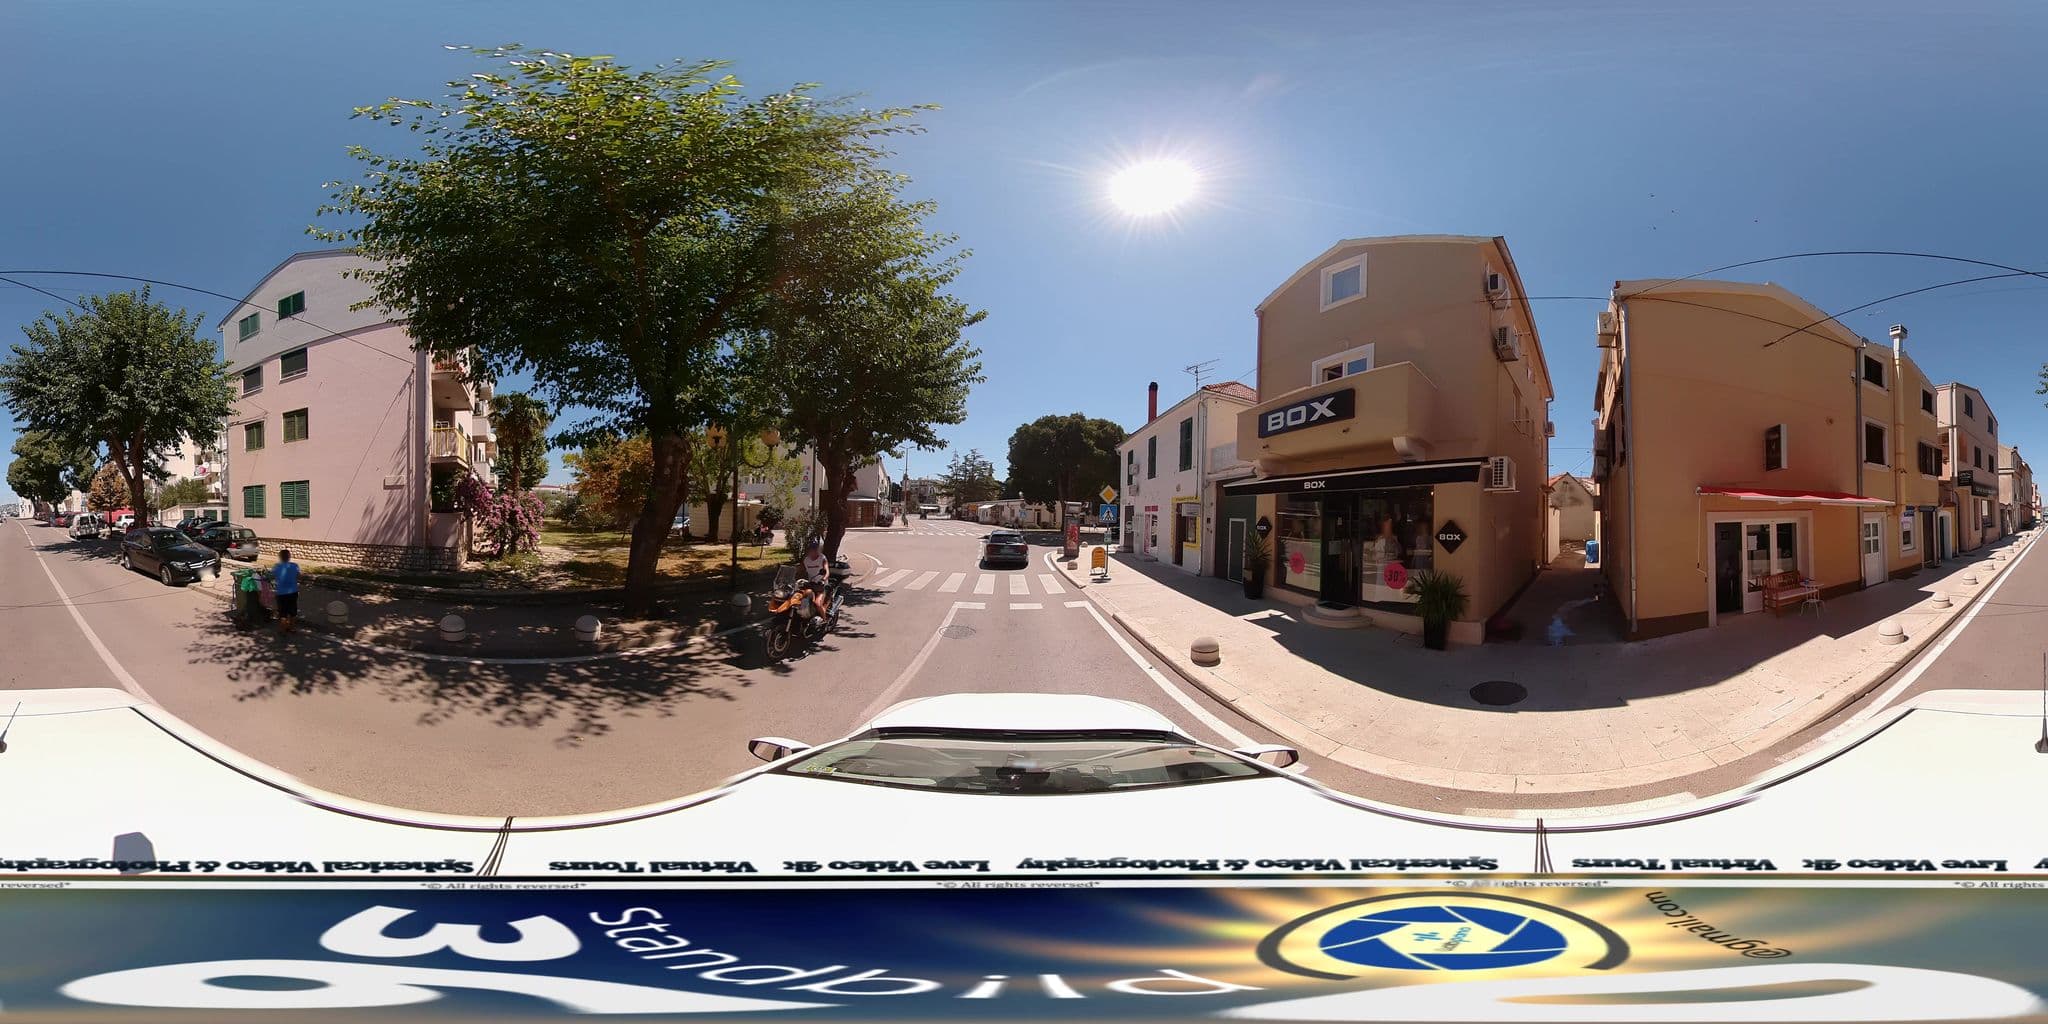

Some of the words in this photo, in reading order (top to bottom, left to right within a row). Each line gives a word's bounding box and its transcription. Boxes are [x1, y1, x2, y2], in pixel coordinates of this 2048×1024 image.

[1267, 396, 1337, 432] BOX
[1303, 480, 1326, 490] BOX
[1439, 533, 1461, 541] BOX
